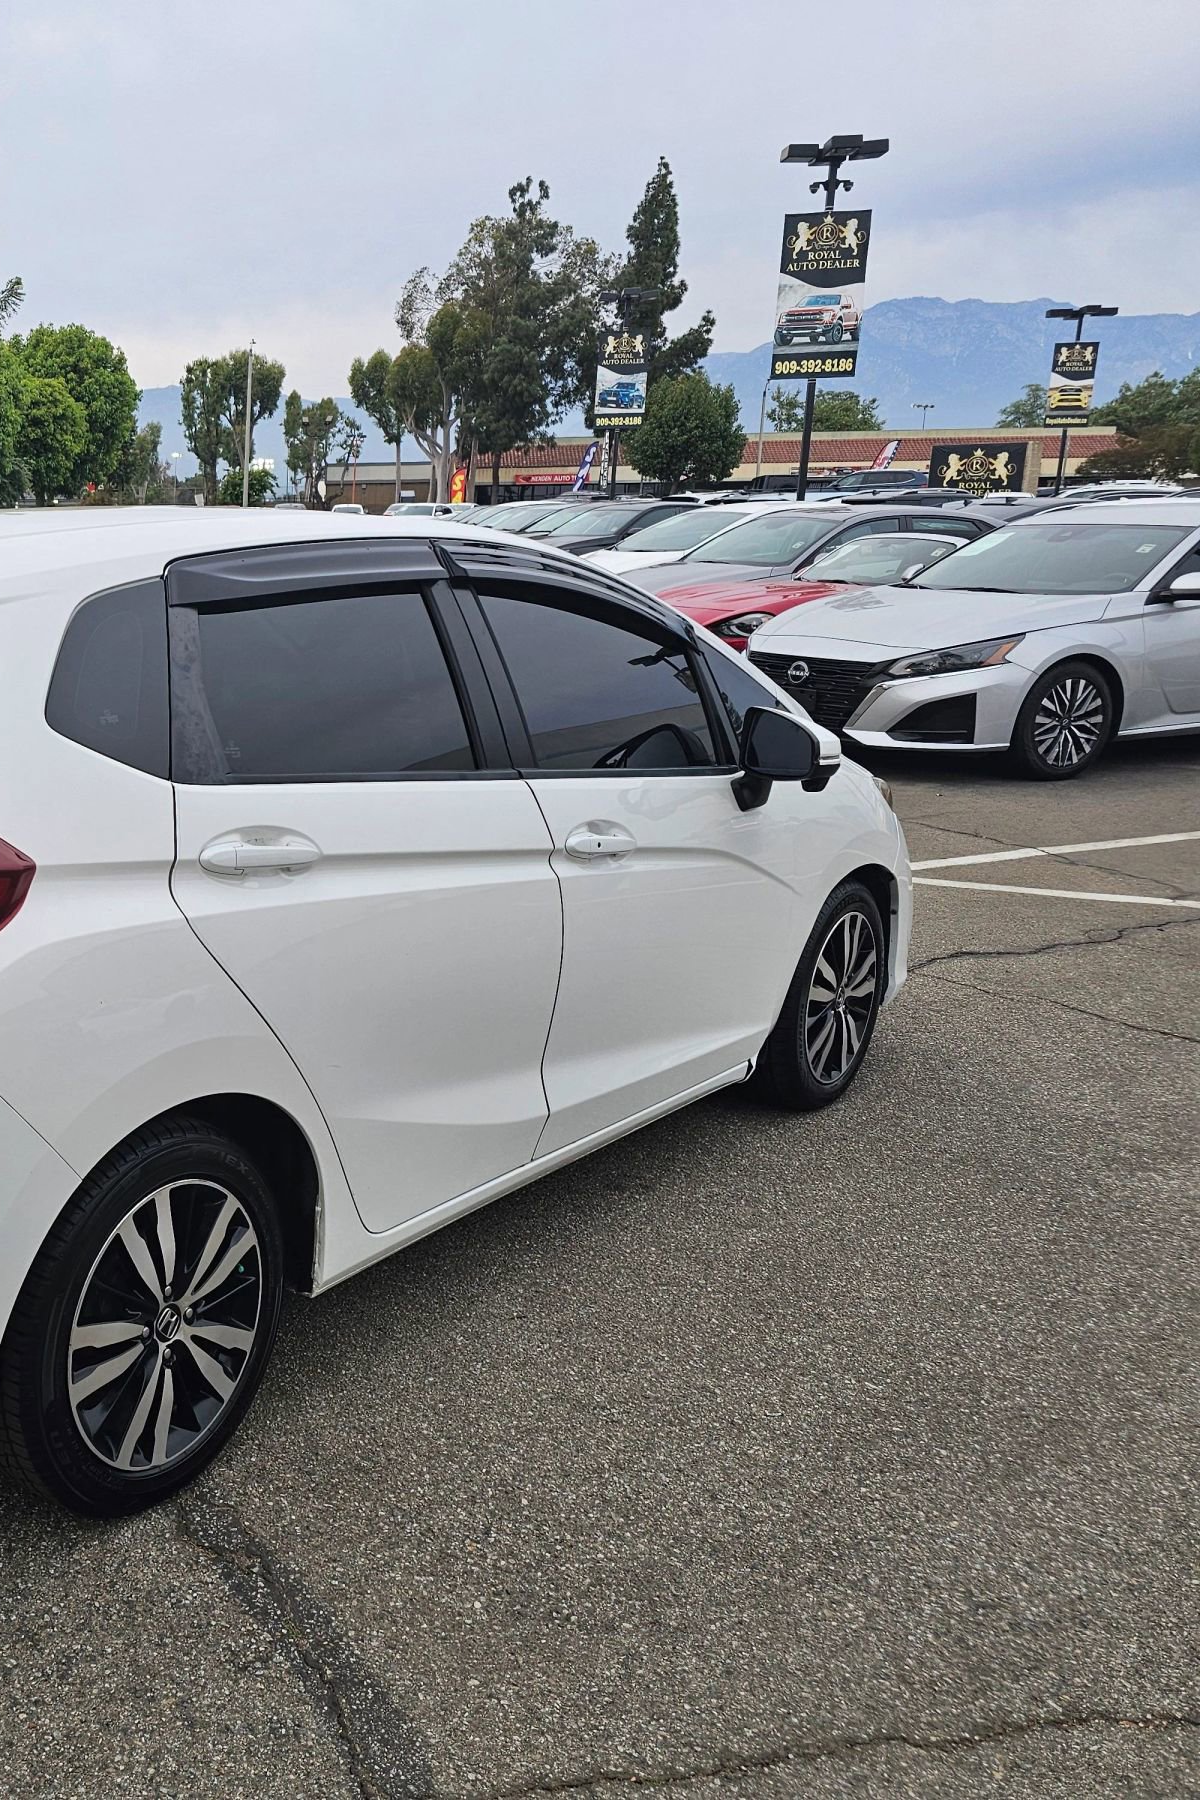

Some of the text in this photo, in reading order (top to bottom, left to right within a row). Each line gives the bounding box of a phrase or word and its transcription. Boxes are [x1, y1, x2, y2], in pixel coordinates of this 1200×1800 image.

[808, 250, 842, 260] ROYAL
[786, 259, 860, 272] AUTO DEALER
[774, 358, 854, 375] 909-392-8186
[958, 481, 993, 489] ROYAL
